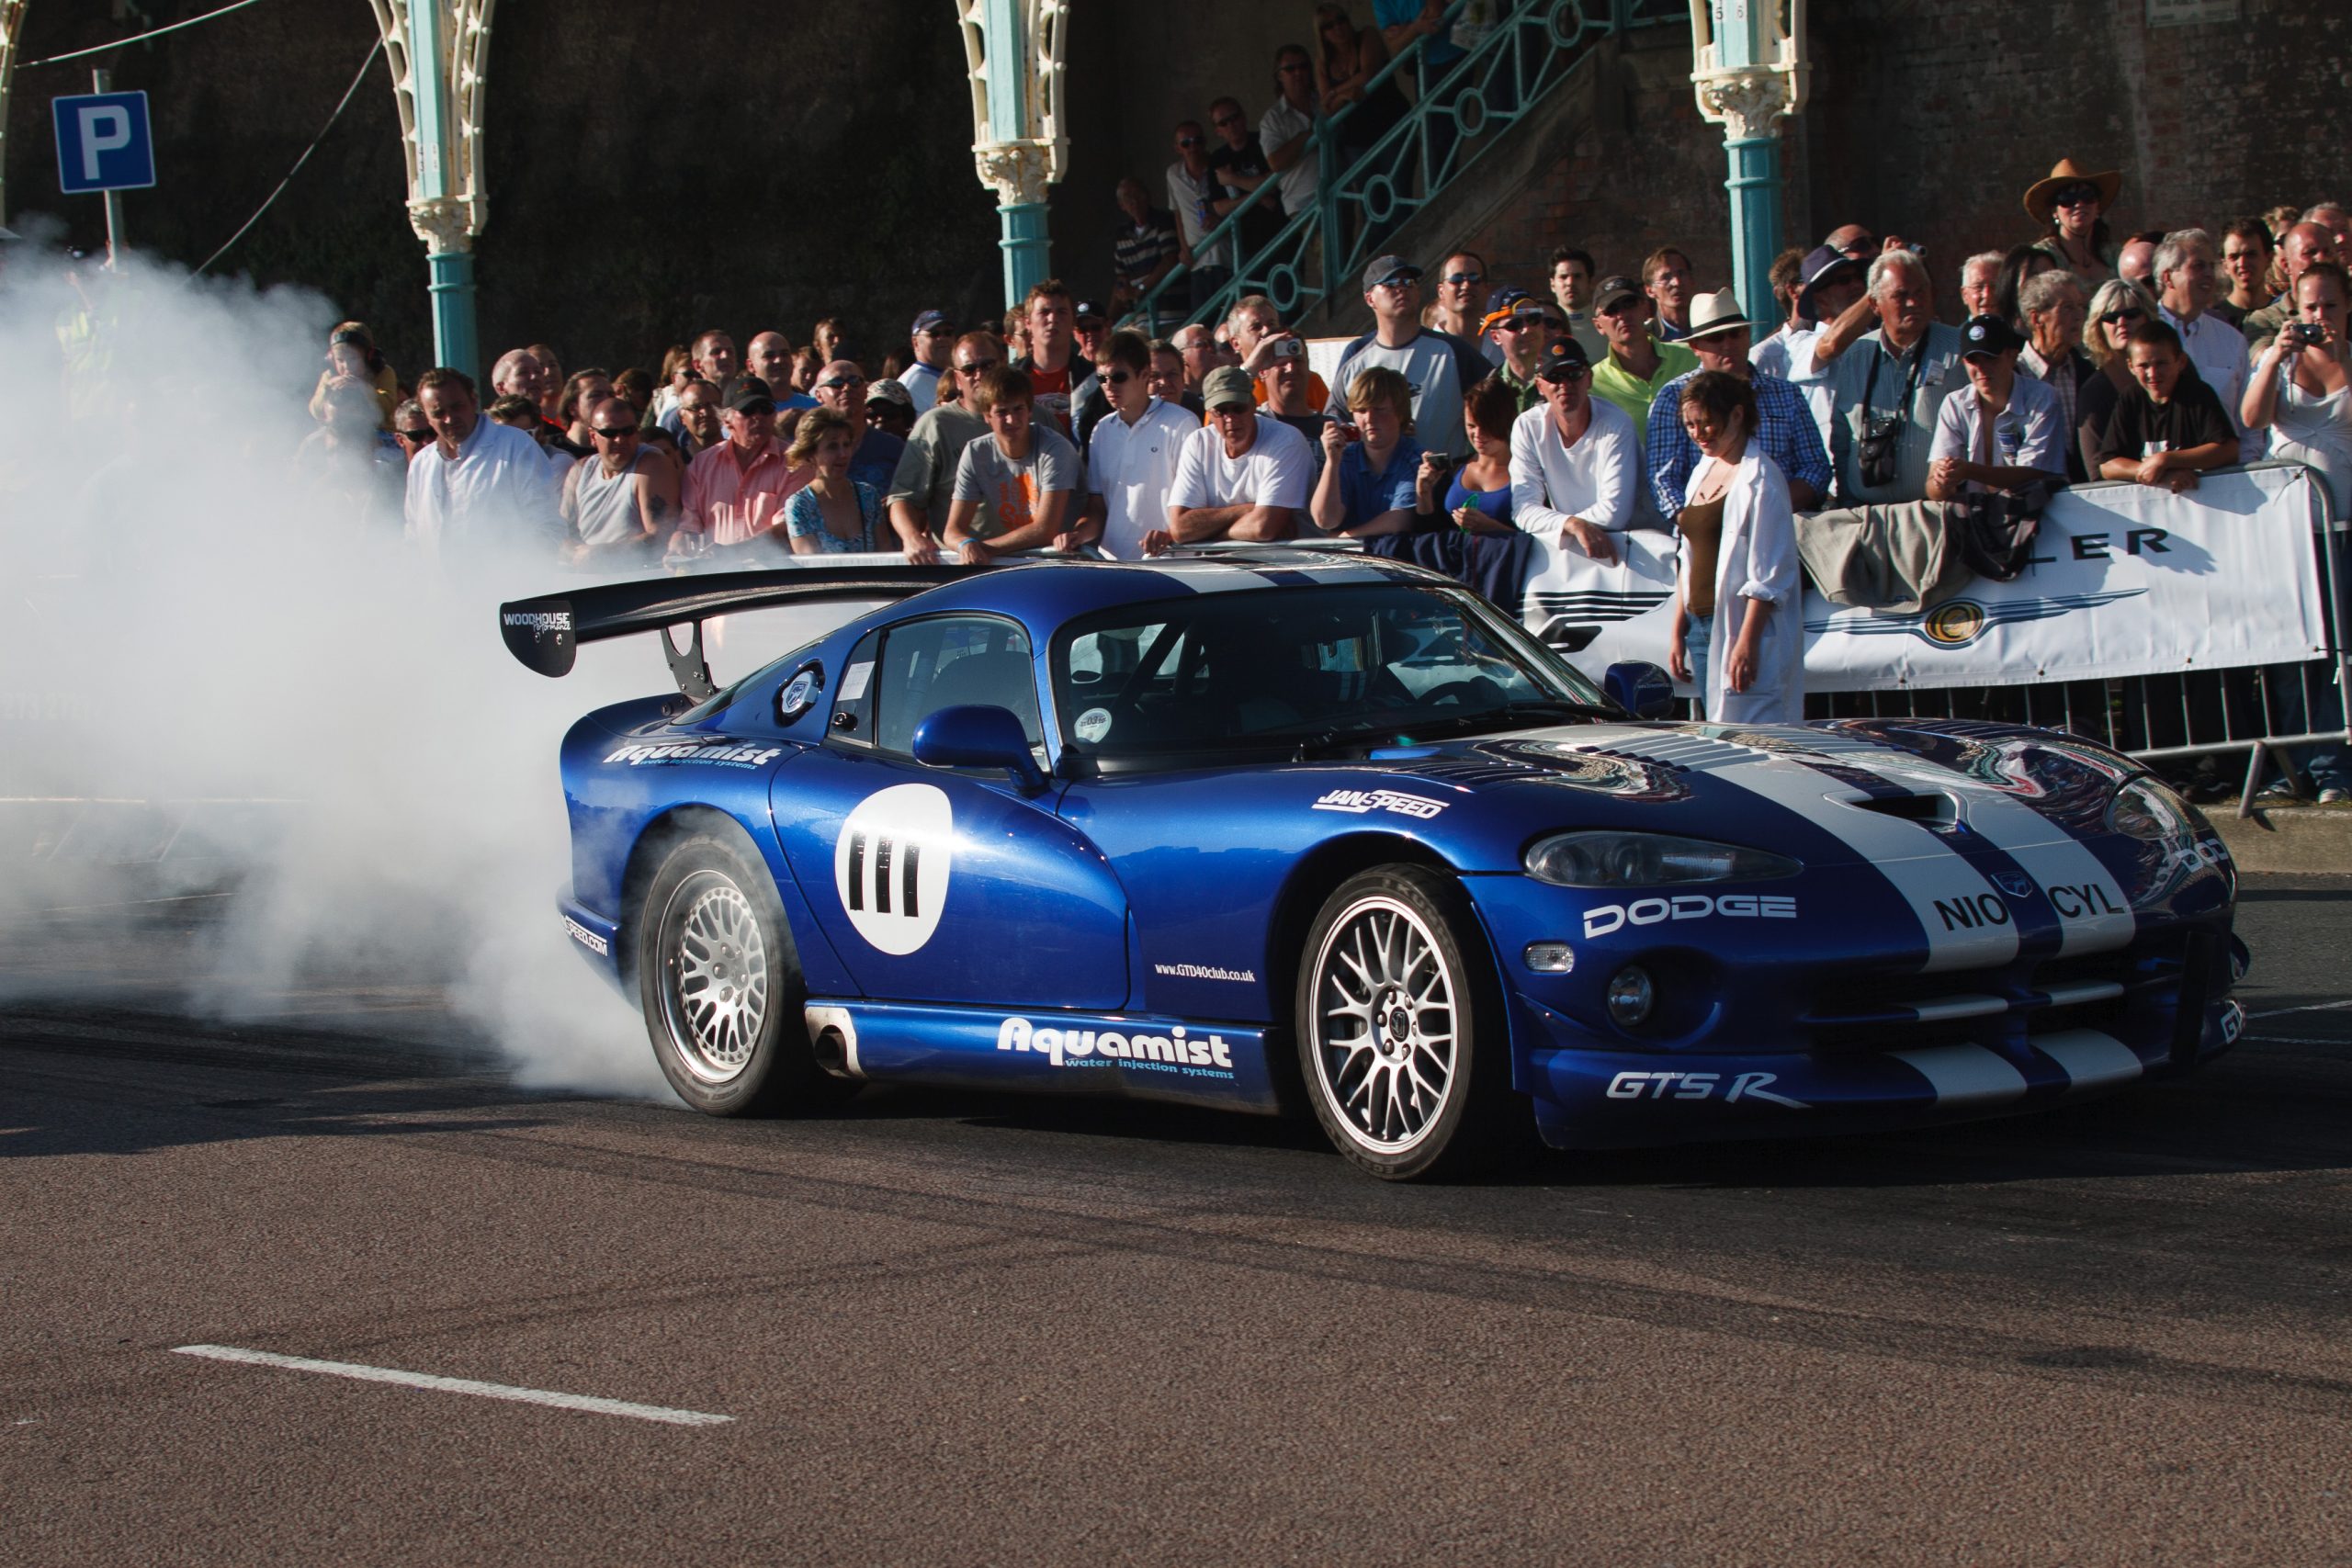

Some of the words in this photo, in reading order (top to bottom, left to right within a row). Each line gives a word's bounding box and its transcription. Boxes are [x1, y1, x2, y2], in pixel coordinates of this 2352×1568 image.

[77, 105, 130, 180] P
[503, 612, 571, 626] WOODHOUSE
[603, 743, 782, 766] Aquamist
[640, 757, 668, 765] water
[670, 758, 712, 766] injection
[715, 760, 758, 770] systems
[1311, 789, 1451, 819] JANSPEED
[849, 831, 921, 918] 111
[1583, 895, 1797, 939] DODGE
[2048, 884, 2125, 919] CYL
[1155, 964, 1256, 982] www.GTD40club.co.uk
[997, 1017, 1233, 1068] Aquamist
[1065, 1058, 1113, 1068] water
[1118, 1059, 1178, 1074] injection
[1182, 1067, 1235, 1080] systems
[1606, 1071, 1720, 1100] GTS
[1724, 1072, 1814, 1110] R
